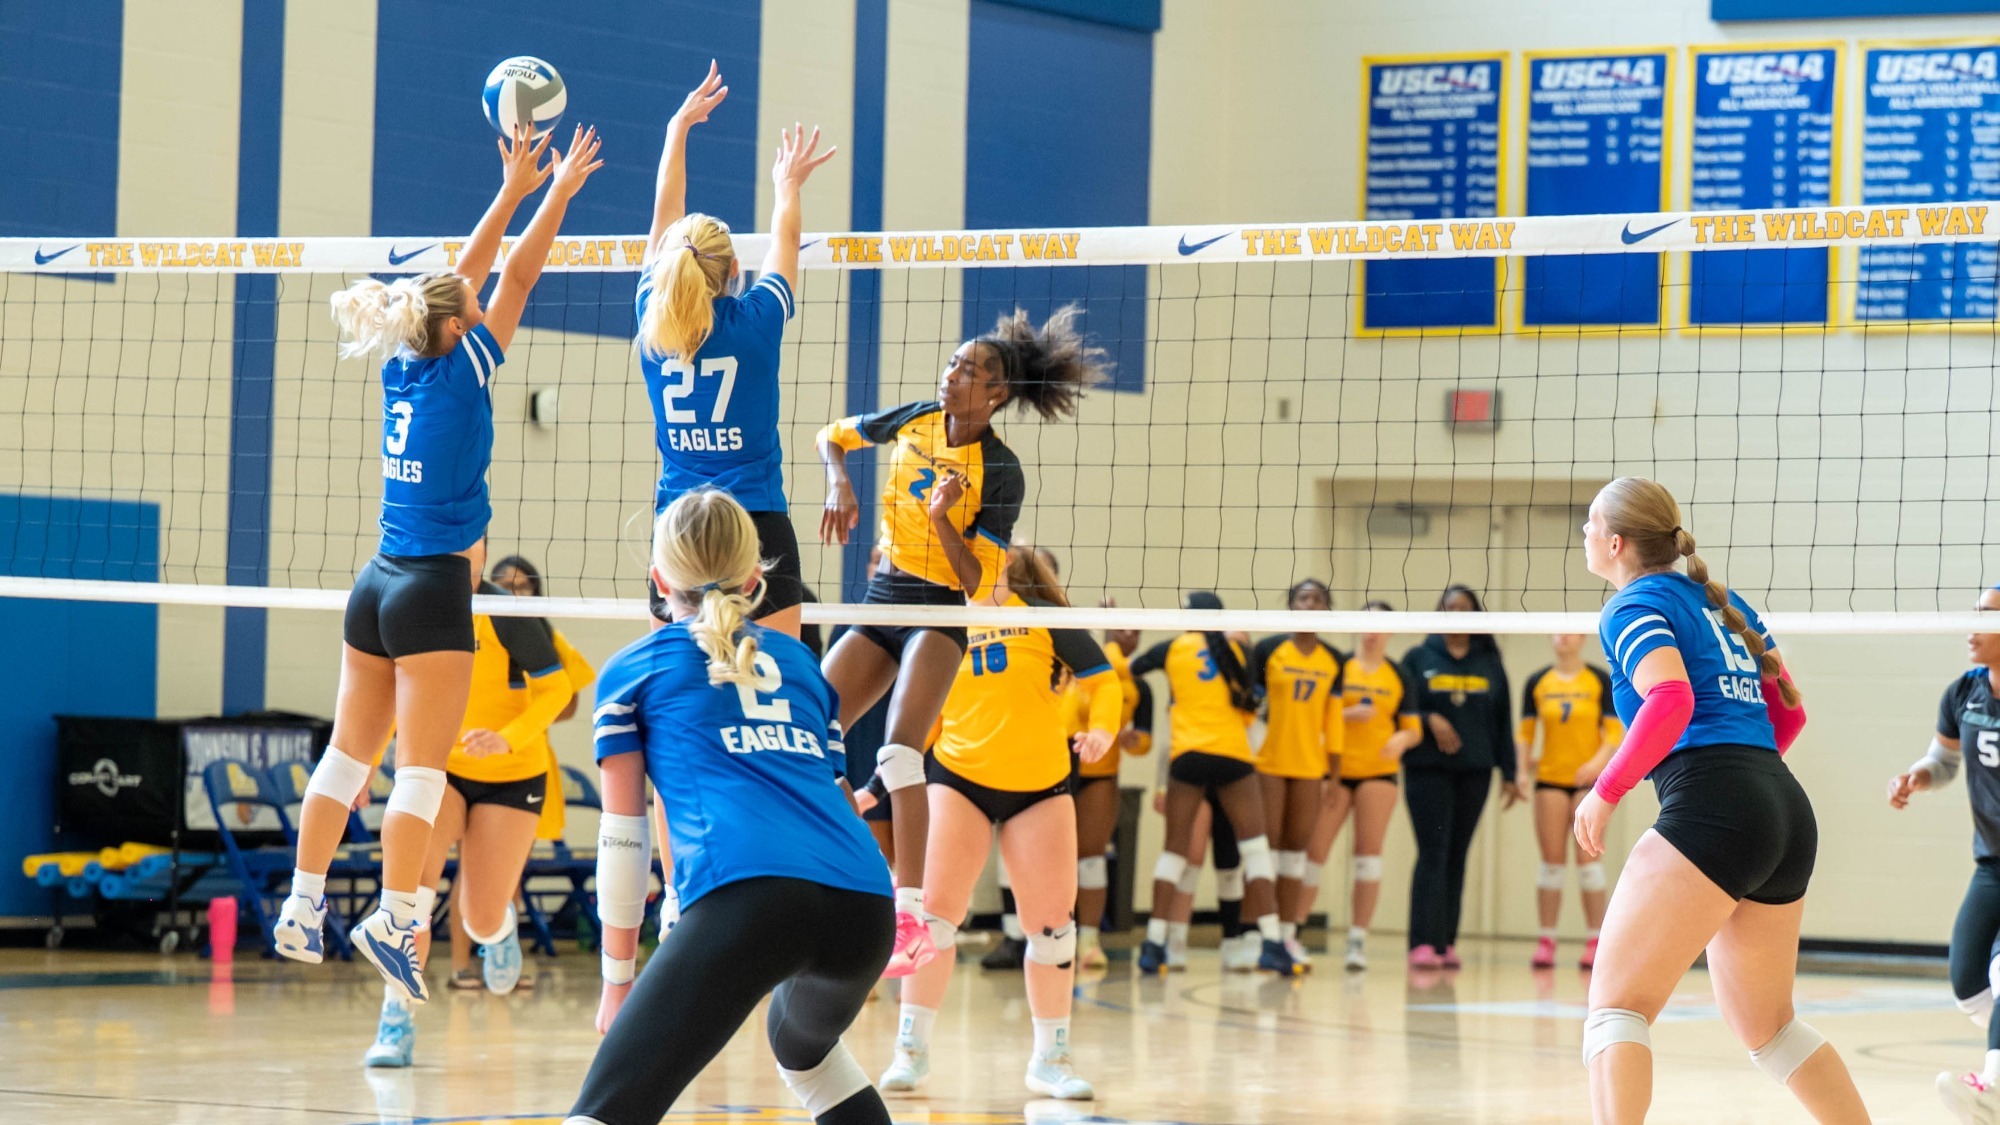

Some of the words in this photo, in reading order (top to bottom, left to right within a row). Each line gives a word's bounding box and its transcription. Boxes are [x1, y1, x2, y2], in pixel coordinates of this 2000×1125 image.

[1379, 64, 1491, 95] USCAA
[1540, 58, 1655, 89] USCAA
[1706, 53, 1825, 85] USCAA
[1876, 51, 1998, 83] USCAA
[1242, 228, 1301, 255] THE
[1308, 224, 1443, 254] WILDCAT
[1450, 222, 1515, 250] WAY
[1691, 214, 1755, 243] THE
[1762, 209, 1909, 241] WILDCAT
[1917, 206, 1988, 236] WAY
[86, 242, 134, 267] THE
[139, 242, 247, 267] WILDCAT
[252, 242, 305, 267] WAY
[828, 237, 883, 263] THE
[888, 234, 1013, 262] WILDCAT
[1019, 233, 1081, 260] WAY
[661, 355, 739, 424] 27
[386, 400, 414, 456] 3
[667, 426, 743, 452] EAGLES
[382, 454, 423, 483] AGLES
[735, 651, 792, 722] 2
[1293, 678, 1317, 701] 17
[1718, 675, 1768, 704] EAGLE
[1561, 702, 1572, 724] 7
[720, 724, 825, 759] EAGLES
[1977, 730, 2000, 768] 5
